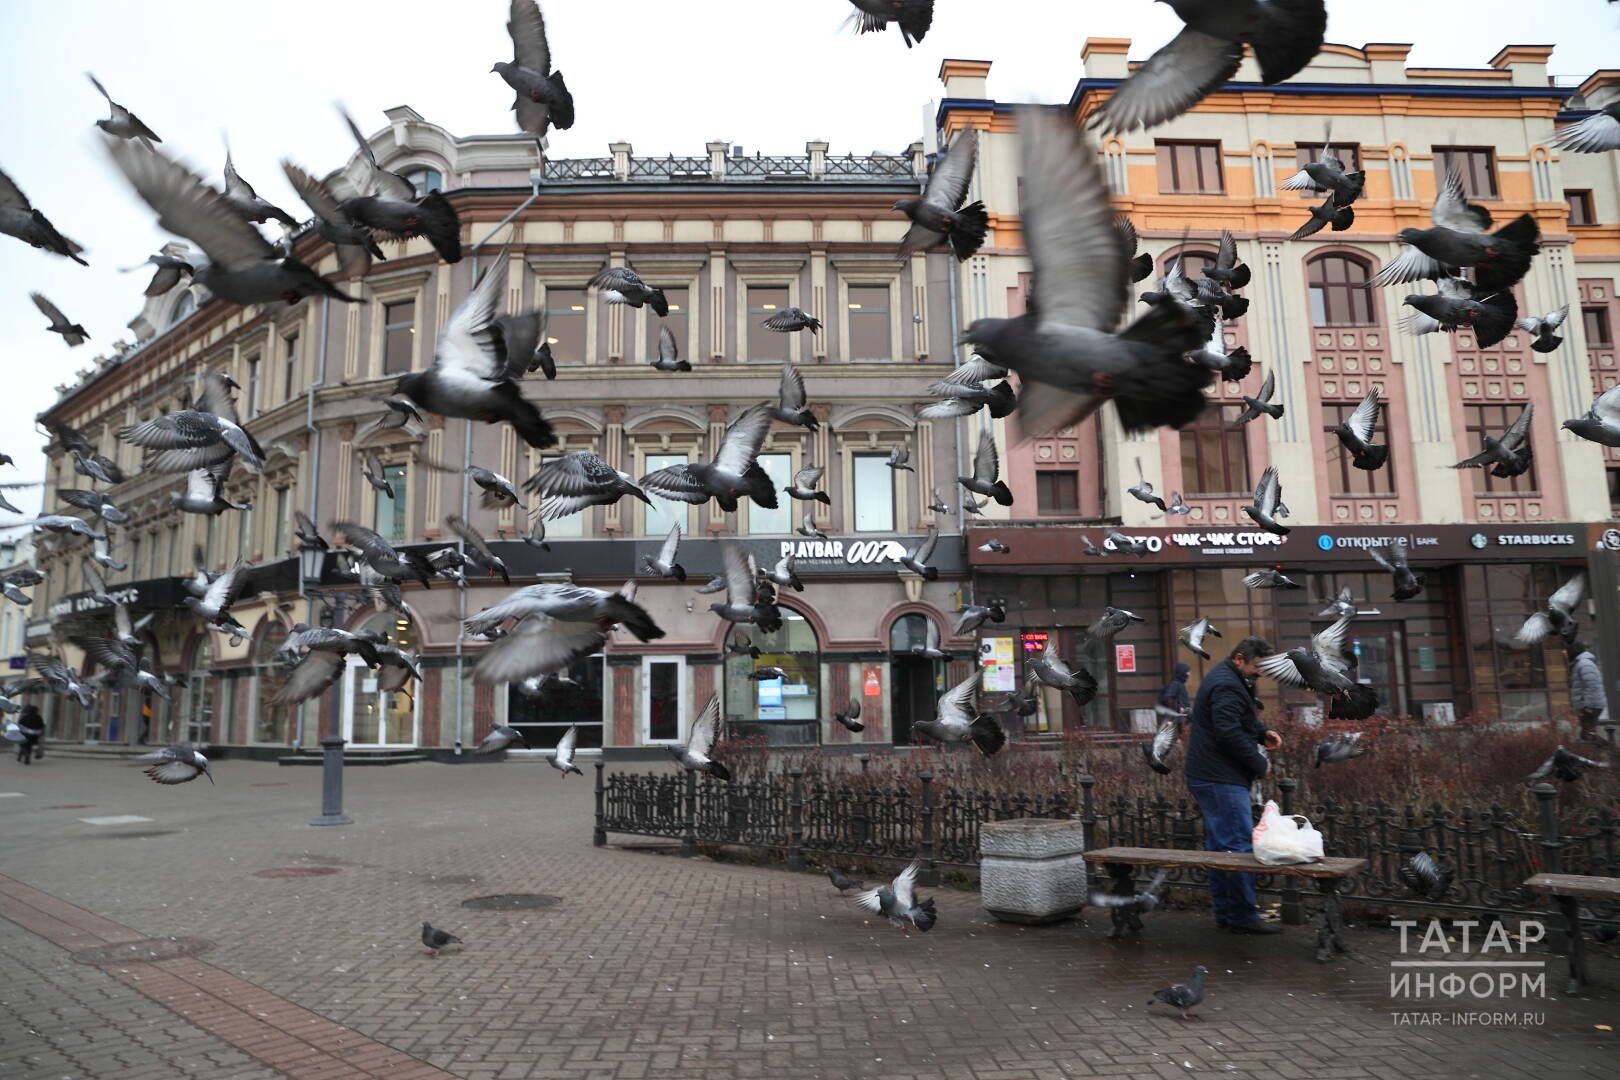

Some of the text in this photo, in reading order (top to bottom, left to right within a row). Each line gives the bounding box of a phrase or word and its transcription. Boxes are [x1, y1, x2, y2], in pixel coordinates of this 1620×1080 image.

[1173, 532, 1282, 546] ЧАК-ЧАК СТОРЕ
[1416, 537, 1439, 545] БАНК
[1498, 535, 1575, 545] STARBUCKS
[780, 541, 902, 564] PLAYBAR 007
